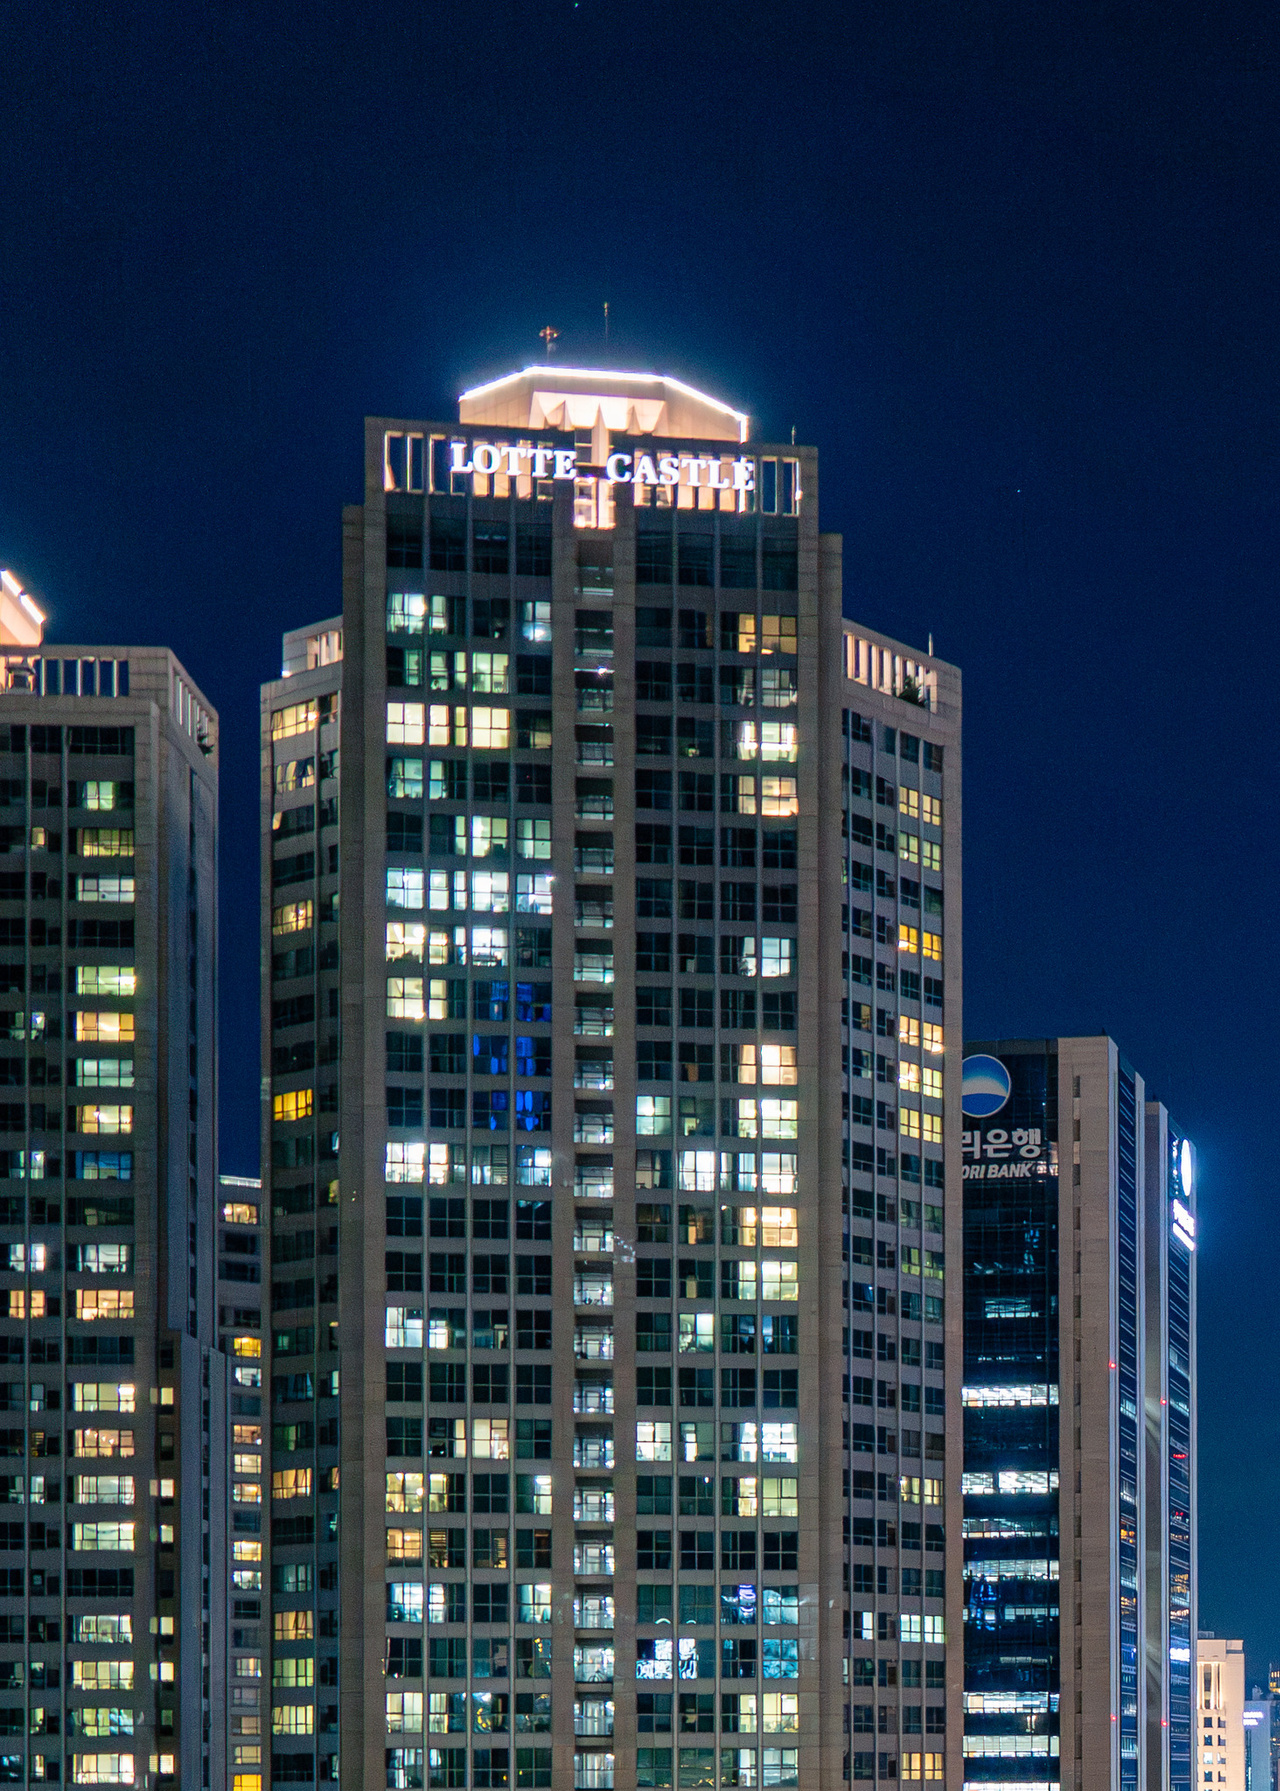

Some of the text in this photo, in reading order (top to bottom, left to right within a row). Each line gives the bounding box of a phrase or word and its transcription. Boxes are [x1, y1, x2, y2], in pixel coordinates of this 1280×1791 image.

[450, 443, 756, 491] LOTTE CASTLE
[962, 1128, 1042, 1159] 리은행
[962, 1161, 1034, 1180] ORI BANK
